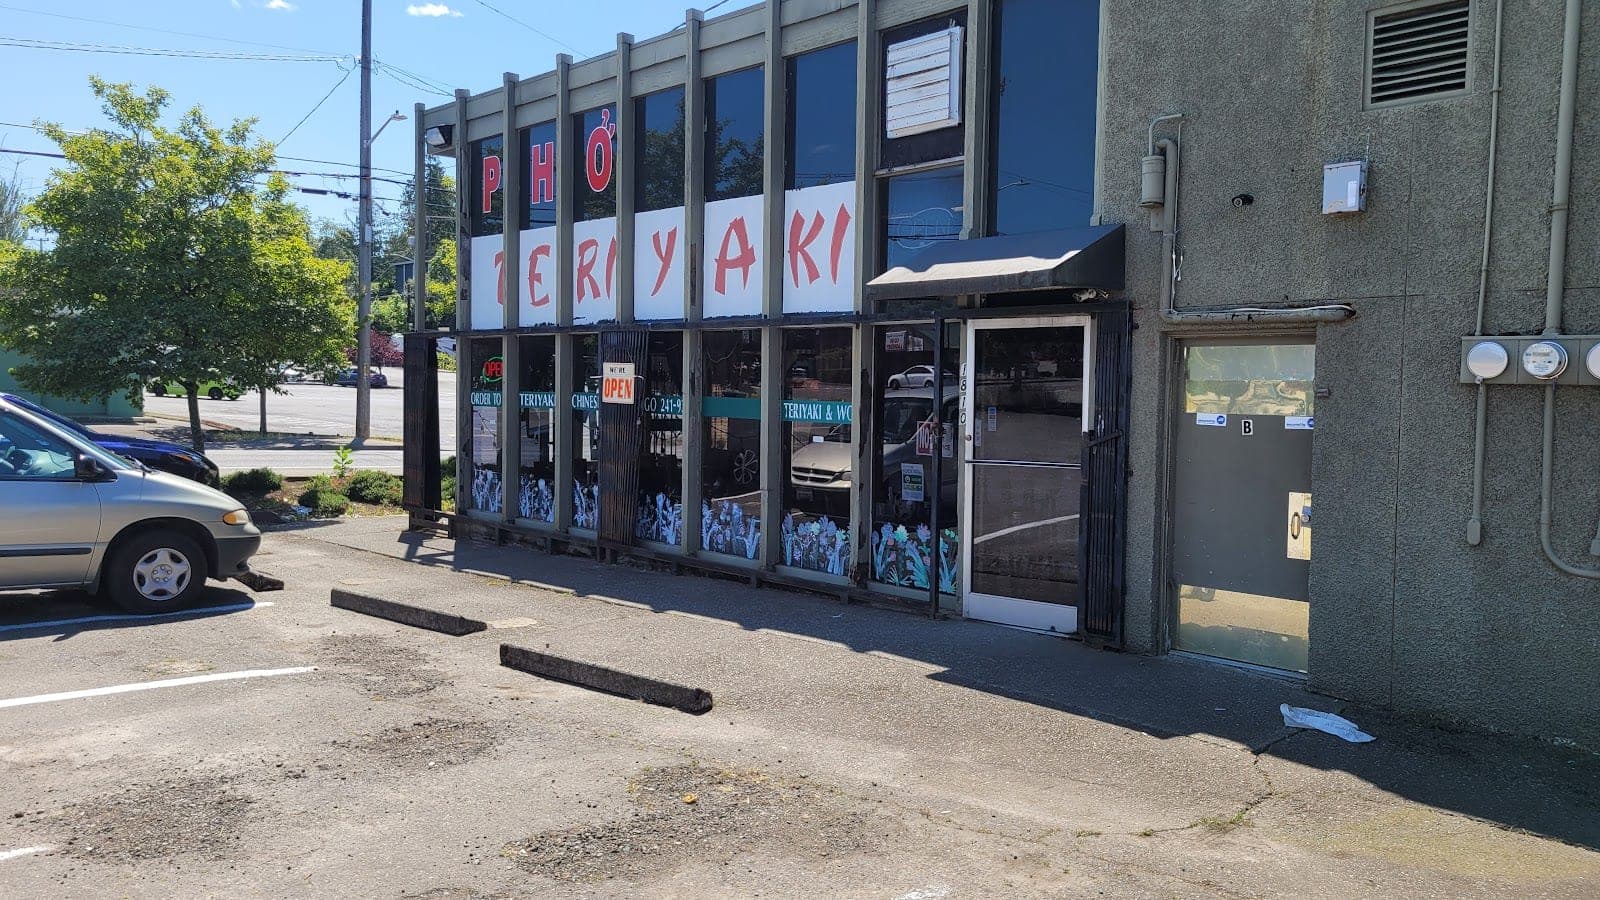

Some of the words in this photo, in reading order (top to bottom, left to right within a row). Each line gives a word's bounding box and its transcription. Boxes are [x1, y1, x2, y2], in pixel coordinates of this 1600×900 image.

[484, 361, 504, 378] OPE
[604, 377, 632, 399] OPEN
[470, 391, 491, 405] ORDER
[493, 392, 502, 406] TO
[571, 394, 599, 409] CHINES
[644, 397, 657, 412] GO
[660, 398, 683, 413] 241-9
[783, 402, 822, 420] TERIYAKI
[825, 404, 833, 420] &
[836, 404, 852, 421] WO
[1243, 420, 1252, 434] B
